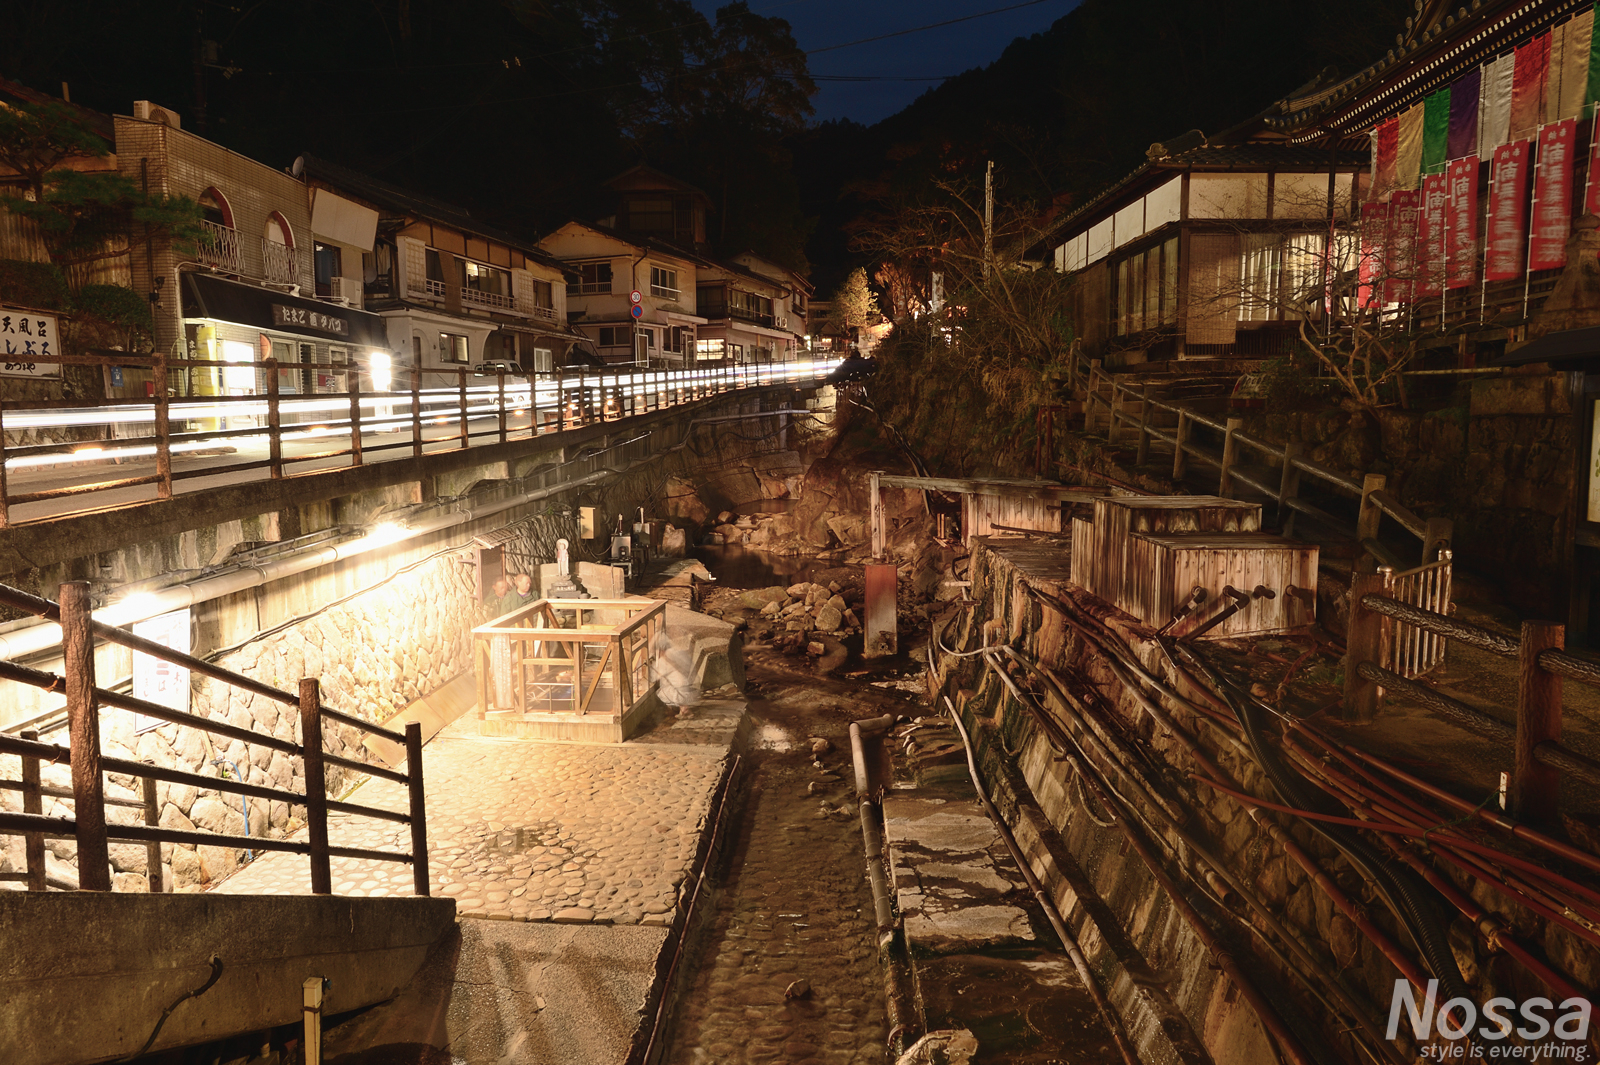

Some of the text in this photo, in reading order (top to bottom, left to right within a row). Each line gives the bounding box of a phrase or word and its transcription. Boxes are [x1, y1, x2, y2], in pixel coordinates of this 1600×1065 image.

[282, 306, 306, 325] たまご
[2, 315, 47, 338] 天風呂
